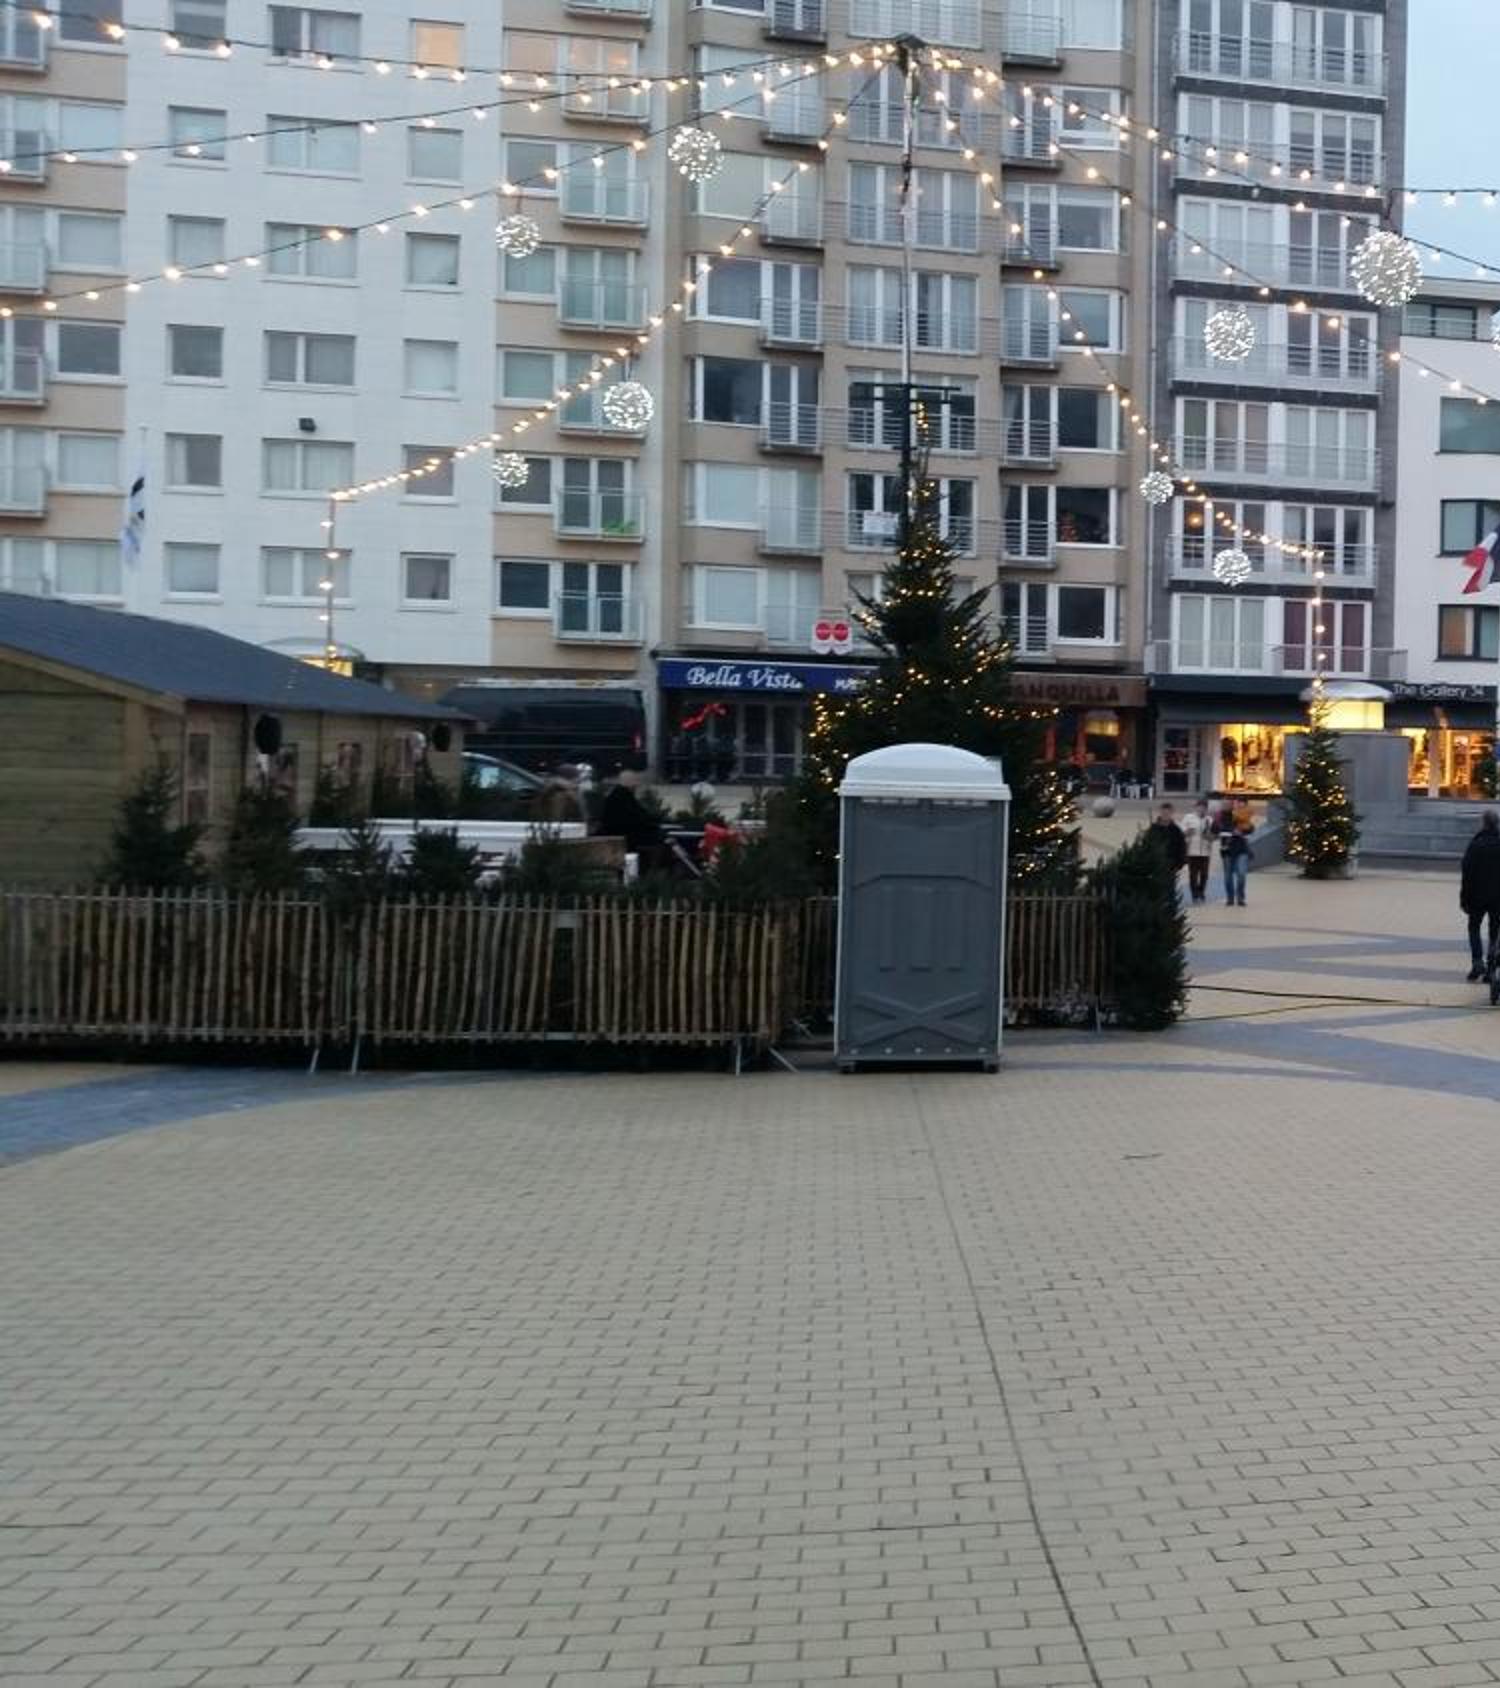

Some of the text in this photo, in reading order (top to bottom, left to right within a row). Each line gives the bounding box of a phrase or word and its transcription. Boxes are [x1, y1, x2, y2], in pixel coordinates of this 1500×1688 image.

[687, 664, 803, 690] Bella Vista
[1393, 683, 1417, 697] The
[1420, 684, 1468, 699] Gallery
